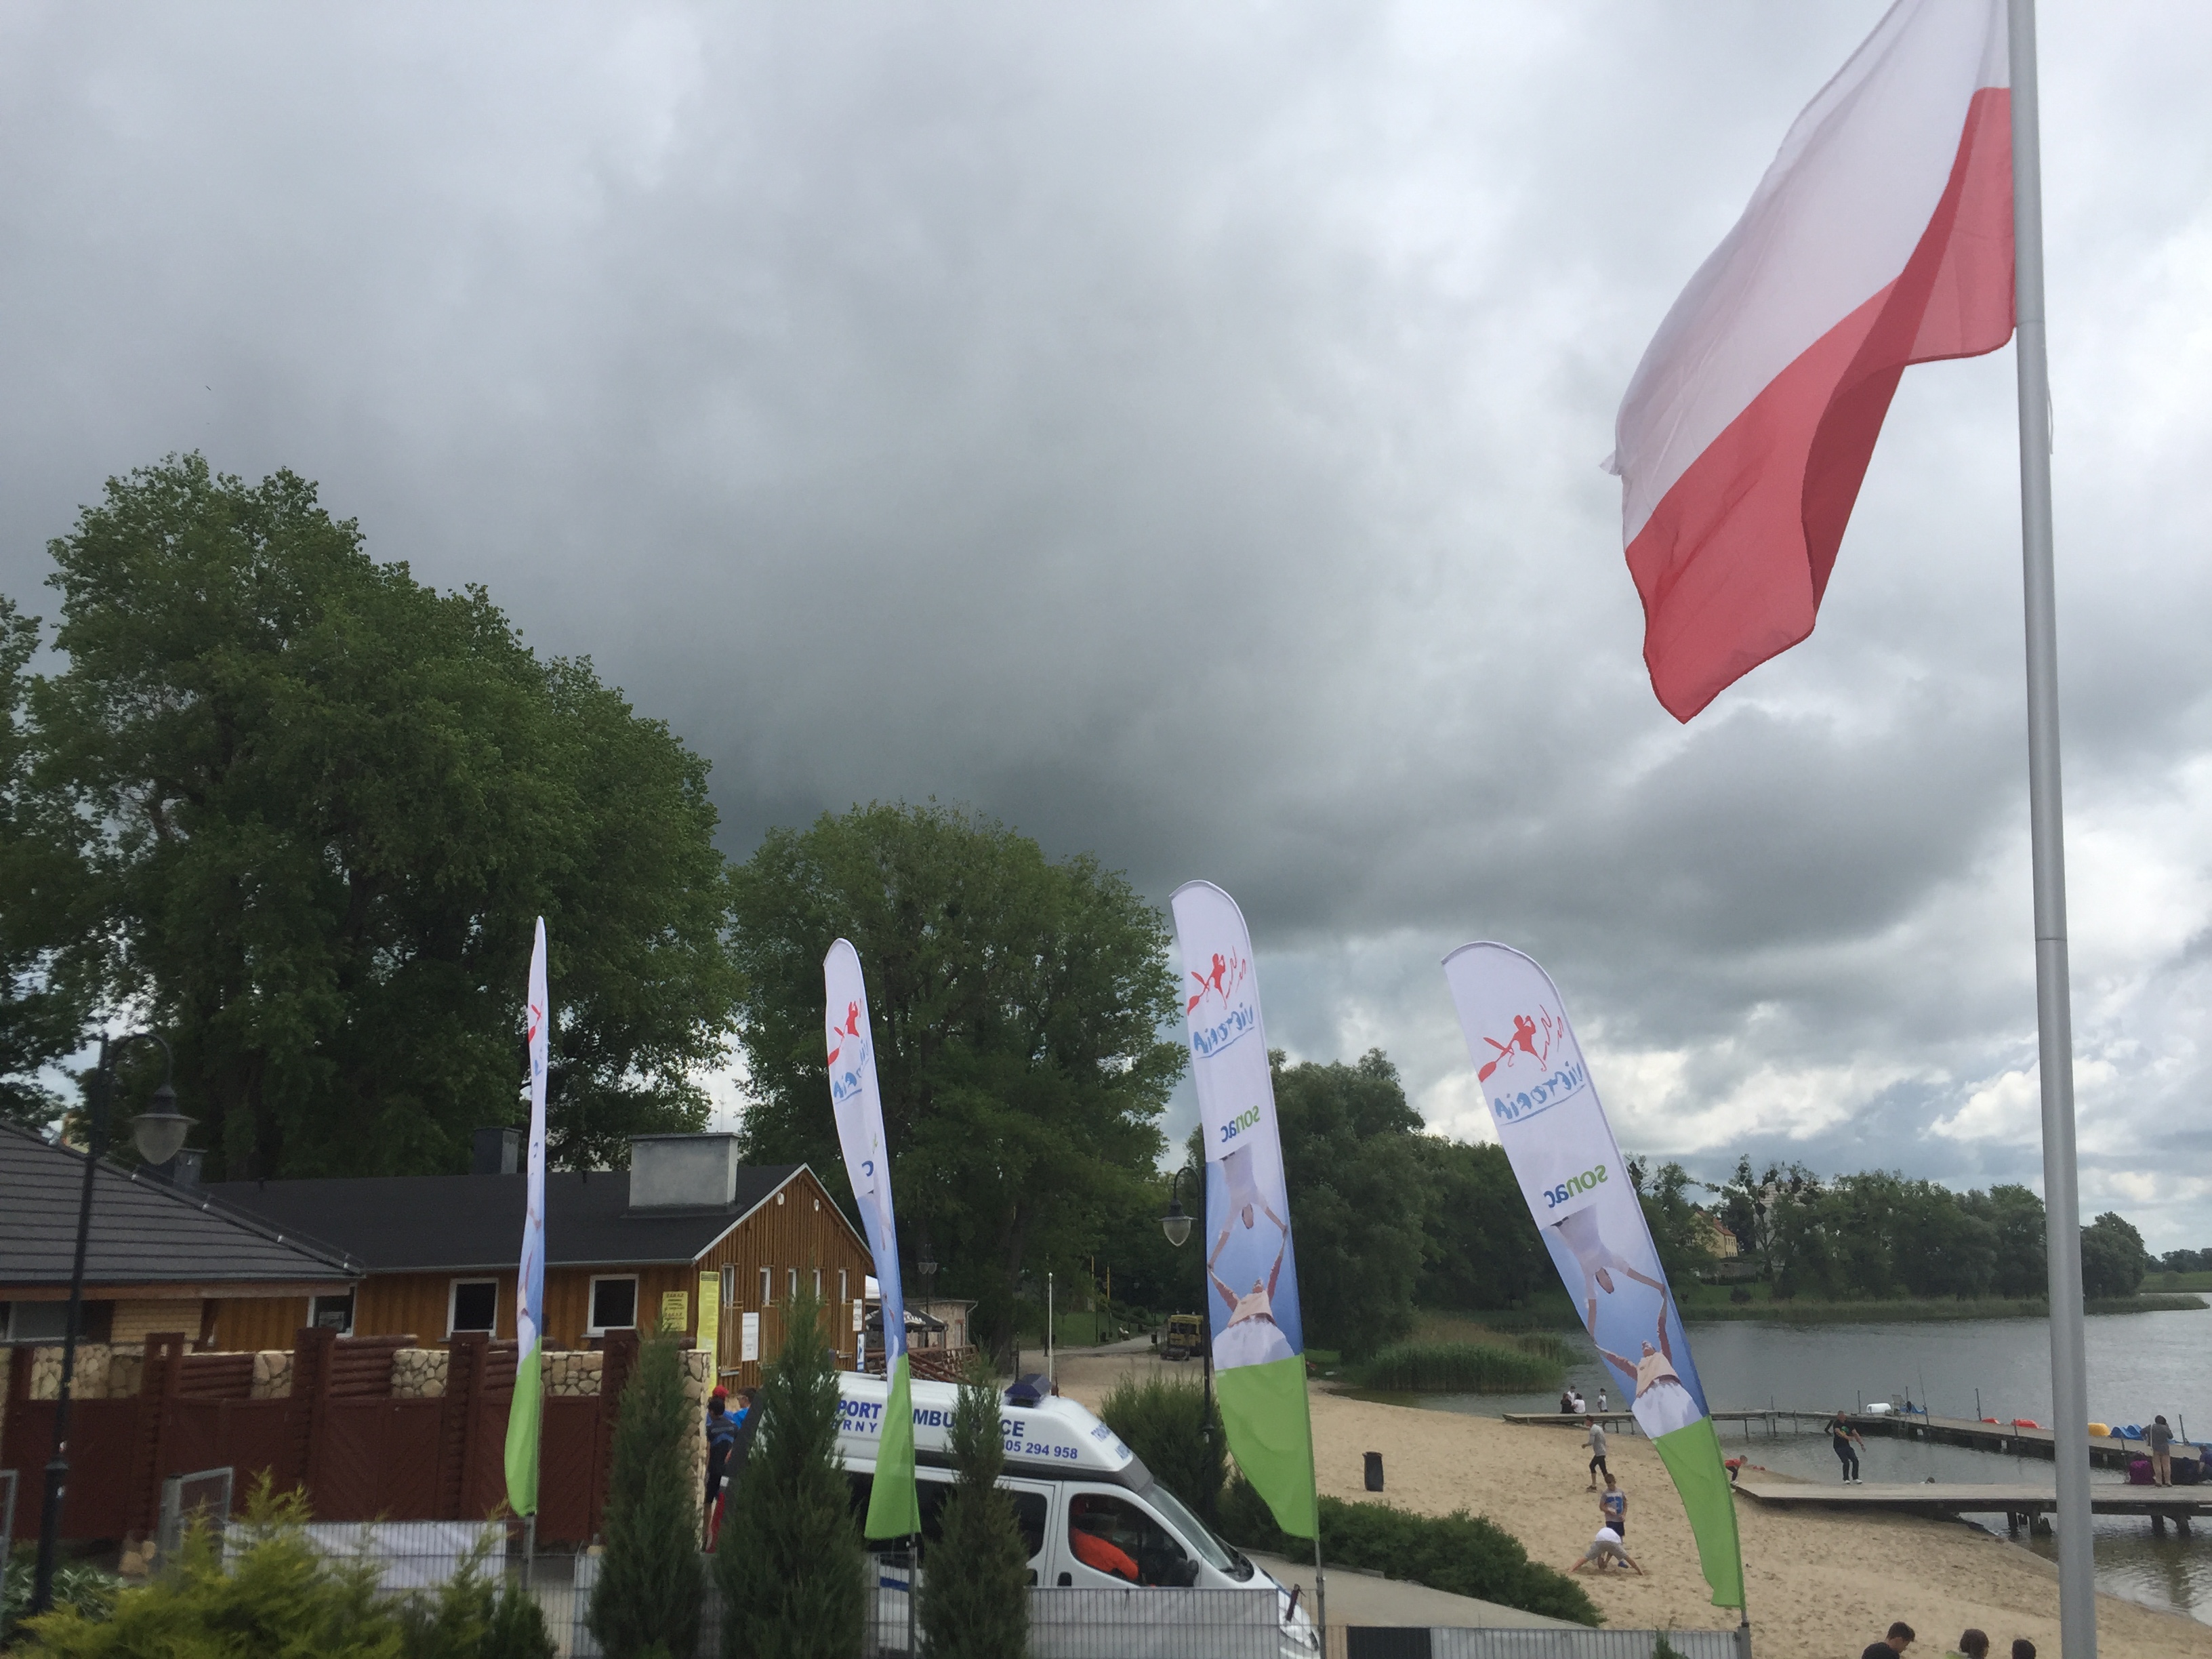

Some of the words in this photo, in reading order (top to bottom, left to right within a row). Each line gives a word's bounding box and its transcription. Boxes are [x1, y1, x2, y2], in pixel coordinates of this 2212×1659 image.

[836, 1399, 882, 1419] PORT
[1002, 1439, 1021, 1452] 05
[1025, 1442, 1049, 1456] 294
[1054, 1446, 1078, 1459] 958
